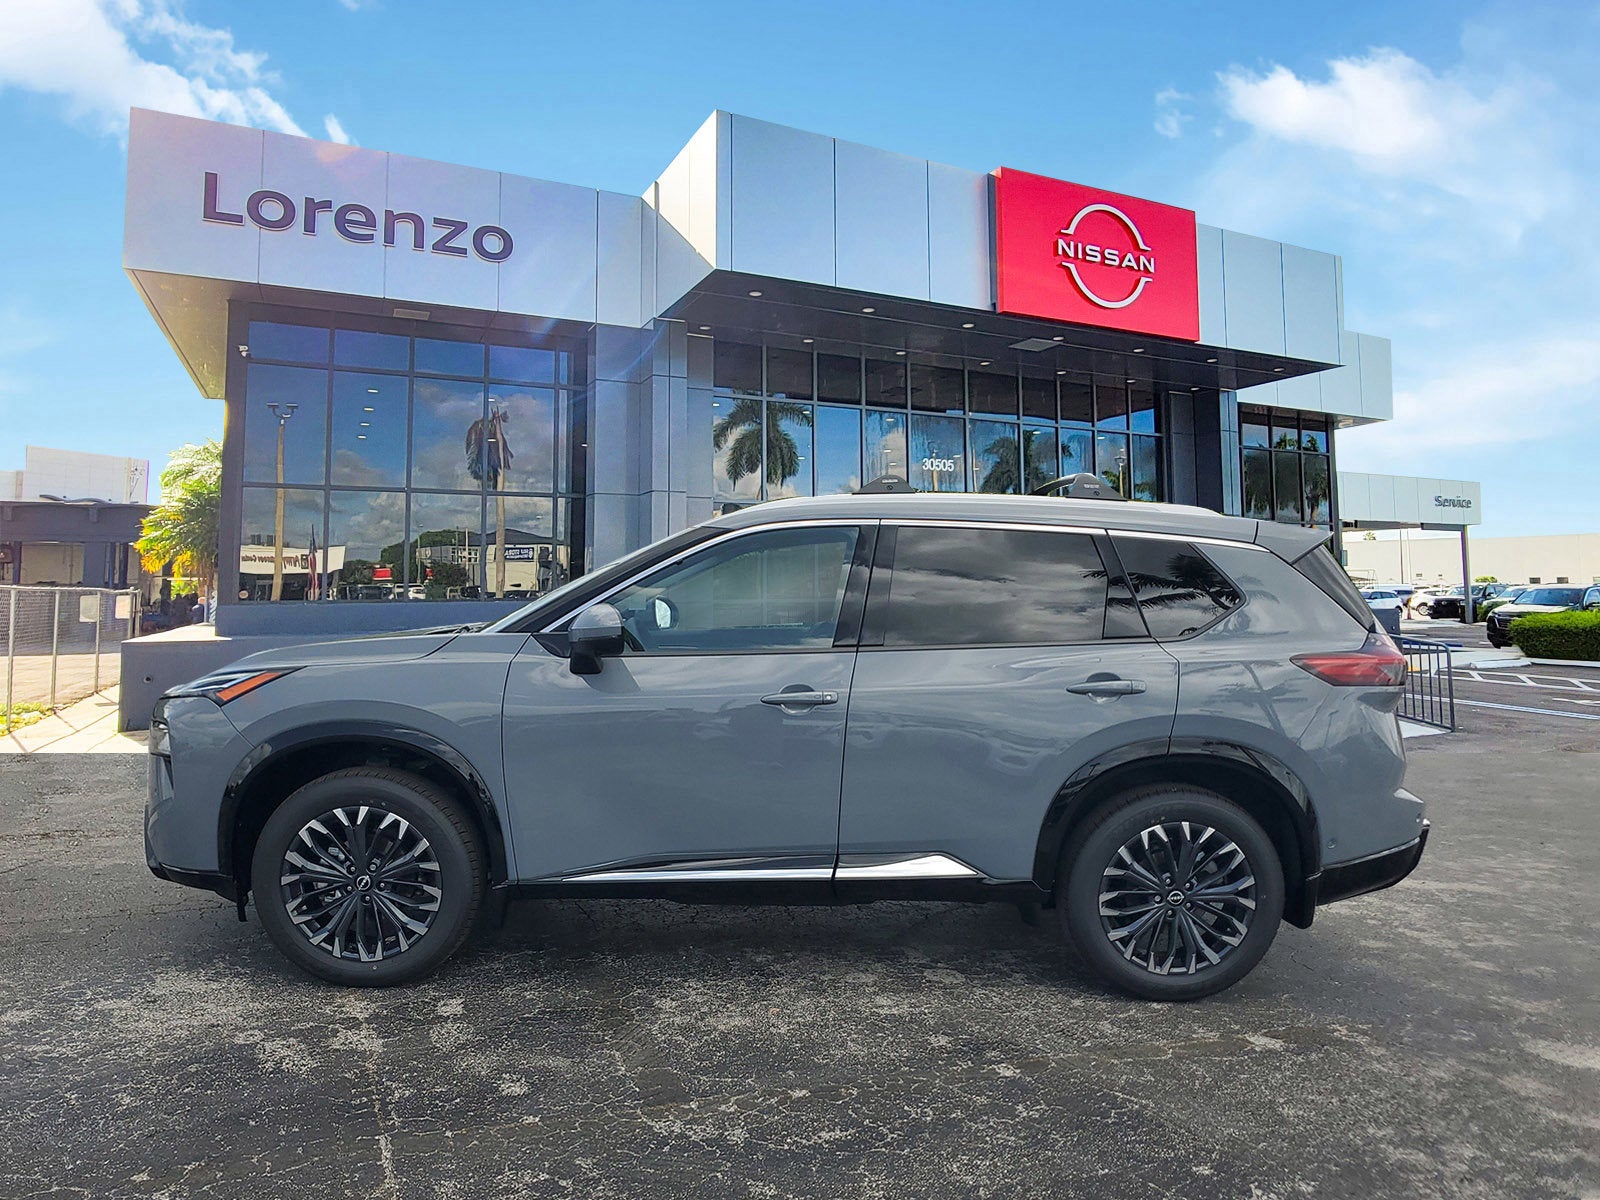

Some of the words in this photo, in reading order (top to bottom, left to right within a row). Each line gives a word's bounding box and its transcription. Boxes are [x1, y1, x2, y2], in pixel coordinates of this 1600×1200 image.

[202, 170, 515, 263] Lorenzo
[1057, 238, 1155, 273] NISSAN
[922, 458, 954, 471] 30505
[1434, 495, 1472, 508] Service
